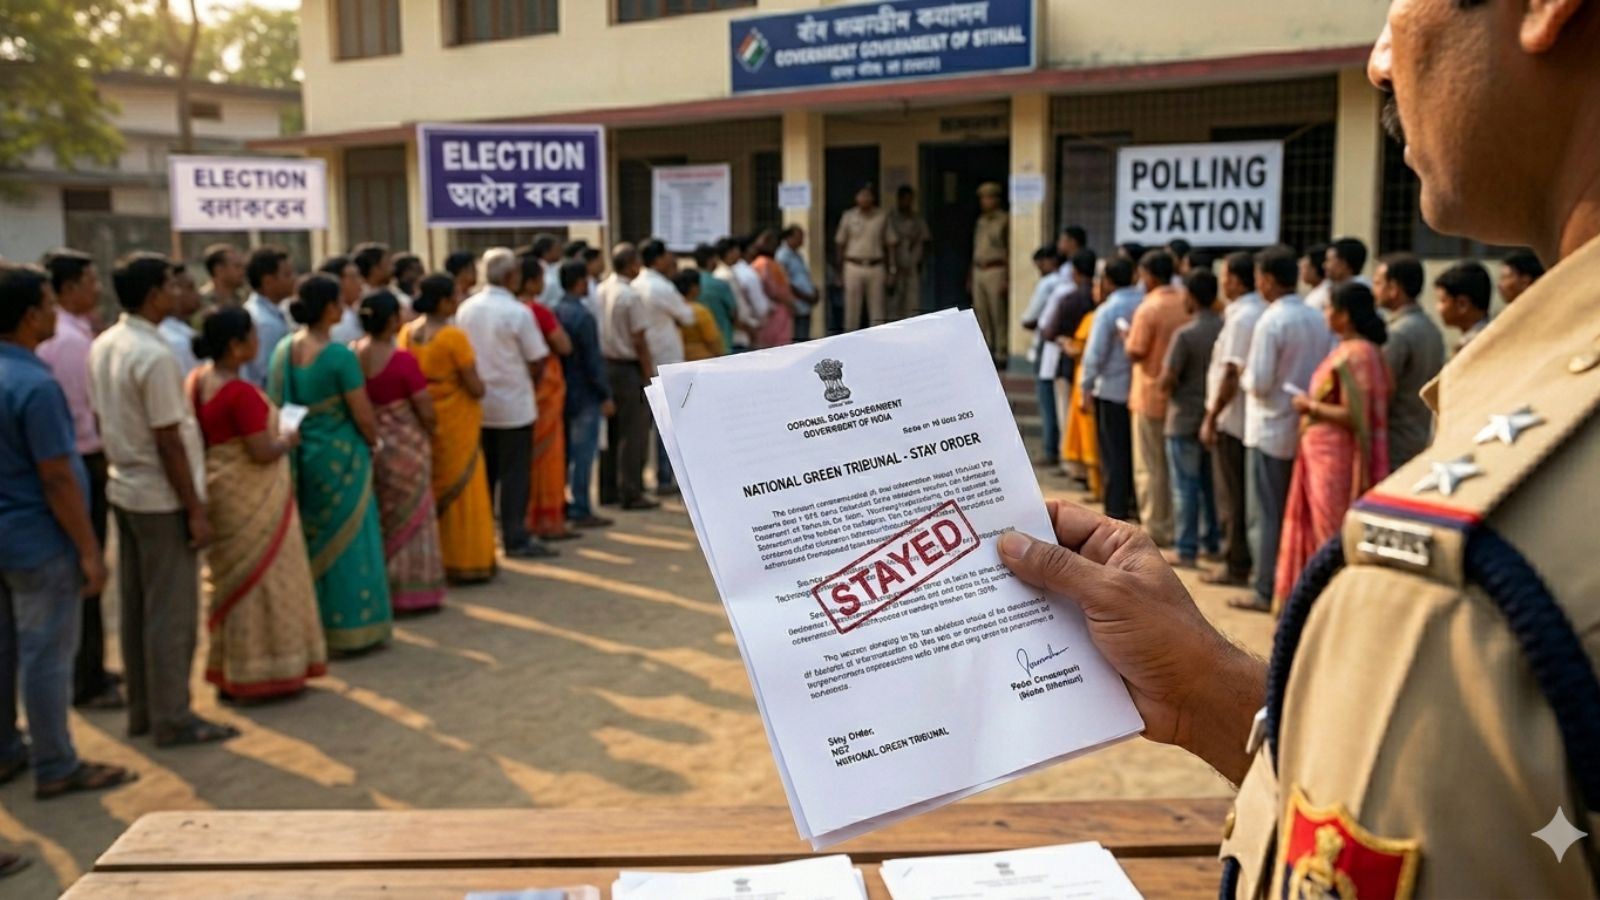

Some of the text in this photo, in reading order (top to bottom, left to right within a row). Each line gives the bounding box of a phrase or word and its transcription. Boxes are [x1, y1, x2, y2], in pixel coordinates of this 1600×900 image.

[442, 141, 585, 171] ELECTION
[194, 168, 307, 191] ELECTION
[1131, 156, 1267, 191] POLLING
[1130, 199, 1265, 233] STATION
[743, 476, 801, 497] NATIONAL
[803, 466, 842, 484] GREEN
[843, 452, 902, 474] TRIBUNAL
[910, 443, 936, 459] STAY
[940, 433, 981, 451] ORDER
[831, 519, 962, 616] STAYED
